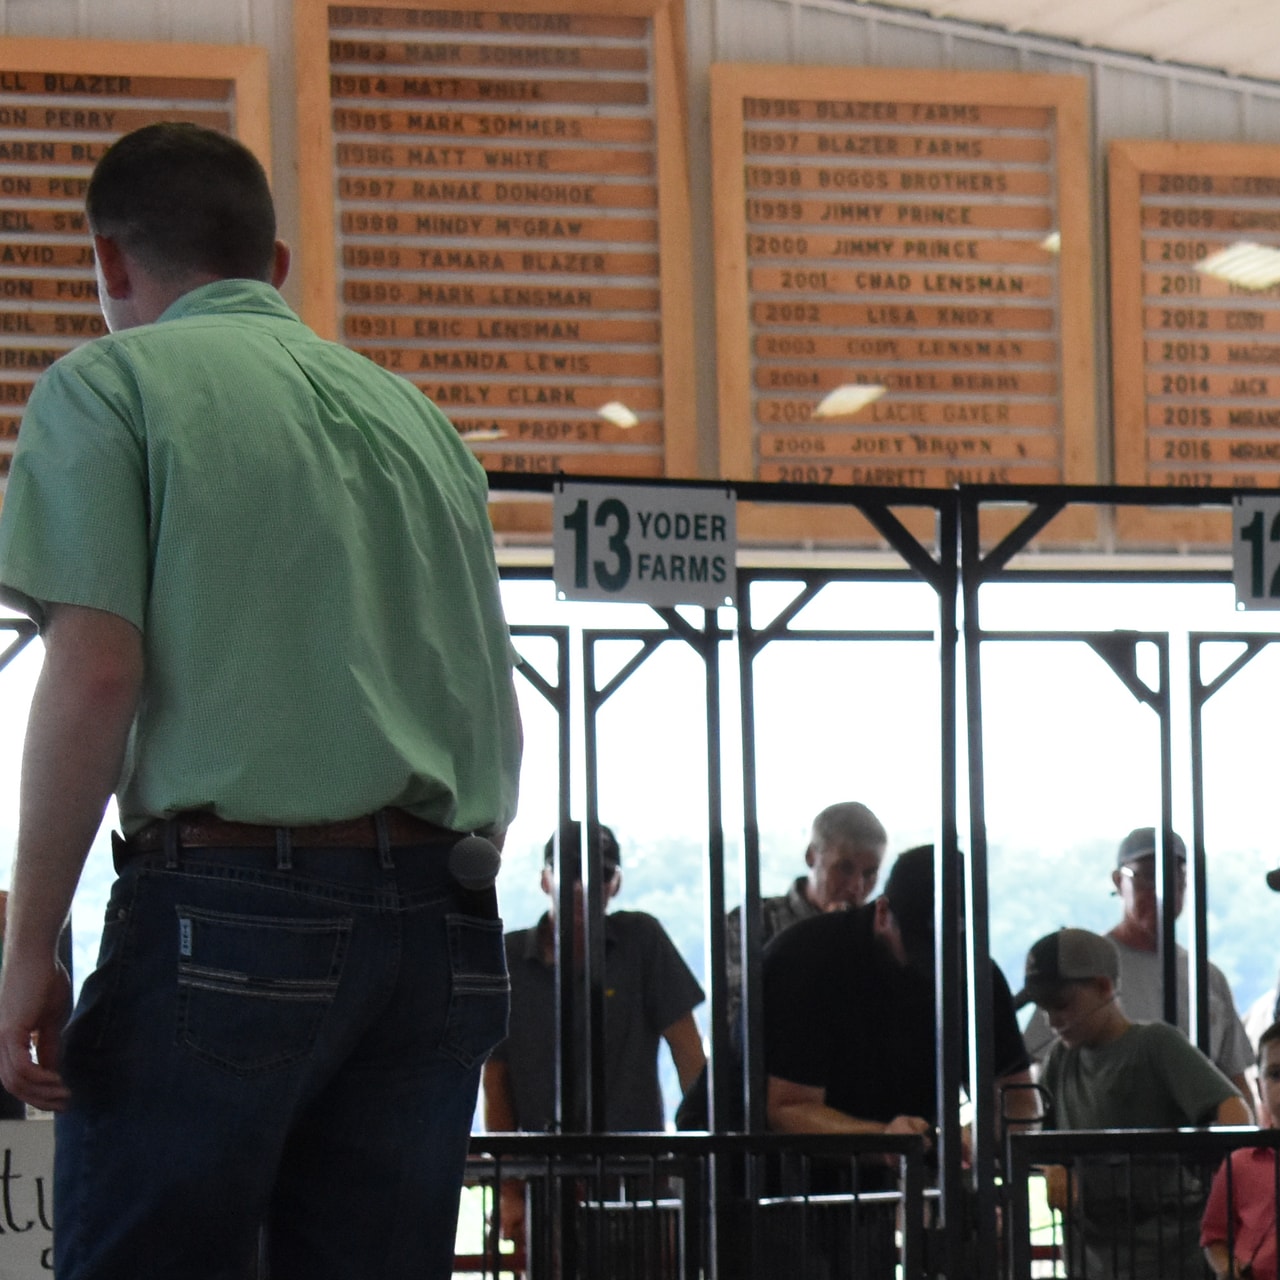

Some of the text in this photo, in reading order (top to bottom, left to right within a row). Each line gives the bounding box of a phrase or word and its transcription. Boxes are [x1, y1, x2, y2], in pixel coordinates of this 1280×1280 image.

[403, 44, 461, 61] MARK
[480, 46, 581, 64] SOMMERS
[44, 75, 132, 93] BLAZER
[335, 77, 541, 98] 1984 MATT WHITE
[45, 111, 116, 128] PERRY
[816, 102, 898, 119] BLAZER
[911, 105, 980, 121] FARMS
[340, 113, 583, 136] 1985 MARK SOMMERS
[751, 134, 983, 157] 1997 BLAZER FARMS
[341, 147, 548, 169] 1986 MATT WHITE
[752, 169, 1007, 192] 1998 BOGGS BROTHERS
[344, 181, 596, 203] 1987 RANAE DONOHOE
[753, 204, 971, 224] 1999 JIMMY PRINCE
[1158, 209, 1213, 227] 2009
[347, 215, 398, 231] 1988
[416, 217, 482, 234] MINDY
[756, 237, 978, 259] 2000 JIMMY PRINCE
[1161, 243, 1208, 260] 2010
[349, 250, 606, 271] 1989 TAMARA BLAZER
[781, 272, 1024, 292] 2001 CHAD LENSMAN
[1160, 276, 1201, 294] 2011
[418, 286, 475, 303] MARK
[489, 288, 592, 306] LENSMAN
[766, 304, 994, 325] 2002 LISA KNOX
[1161, 311, 1209, 328] 2012
[350, 319, 580, 339] 1991 ERIC LENSMAN
[767, 337, 816, 354] 2003
[918, 341, 1023, 357] LENSMAN
[1163, 343, 1210, 361] 2013
[419, 354, 591, 373] AMANDA LEWIS
[770, 371, 819, 387] 2004
[1162, 375, 1210, 393] 2014
[1228, 379, 1268, 395] JACK
[507, 388, 577, 404] CLARK
[770, 403, 815, 422] 200
[871, 404, 929, 422] LACIE
[1164, 408, 1212, 426] 2015
[518, 422, 600, 440] PROPST
[774, 437, 991, 454] 2006 JOEY BROWN
[1165, 441, 1212, 459] 2016
[501, 456, 562, 472] PRICE
[778, 466, 1010, 485] 2007 GARRETT DALLAS
[637, 512, 727, 542] YODER
[563, 498, 632, 593] 13
[637, 553, 727, 584] FARMS
